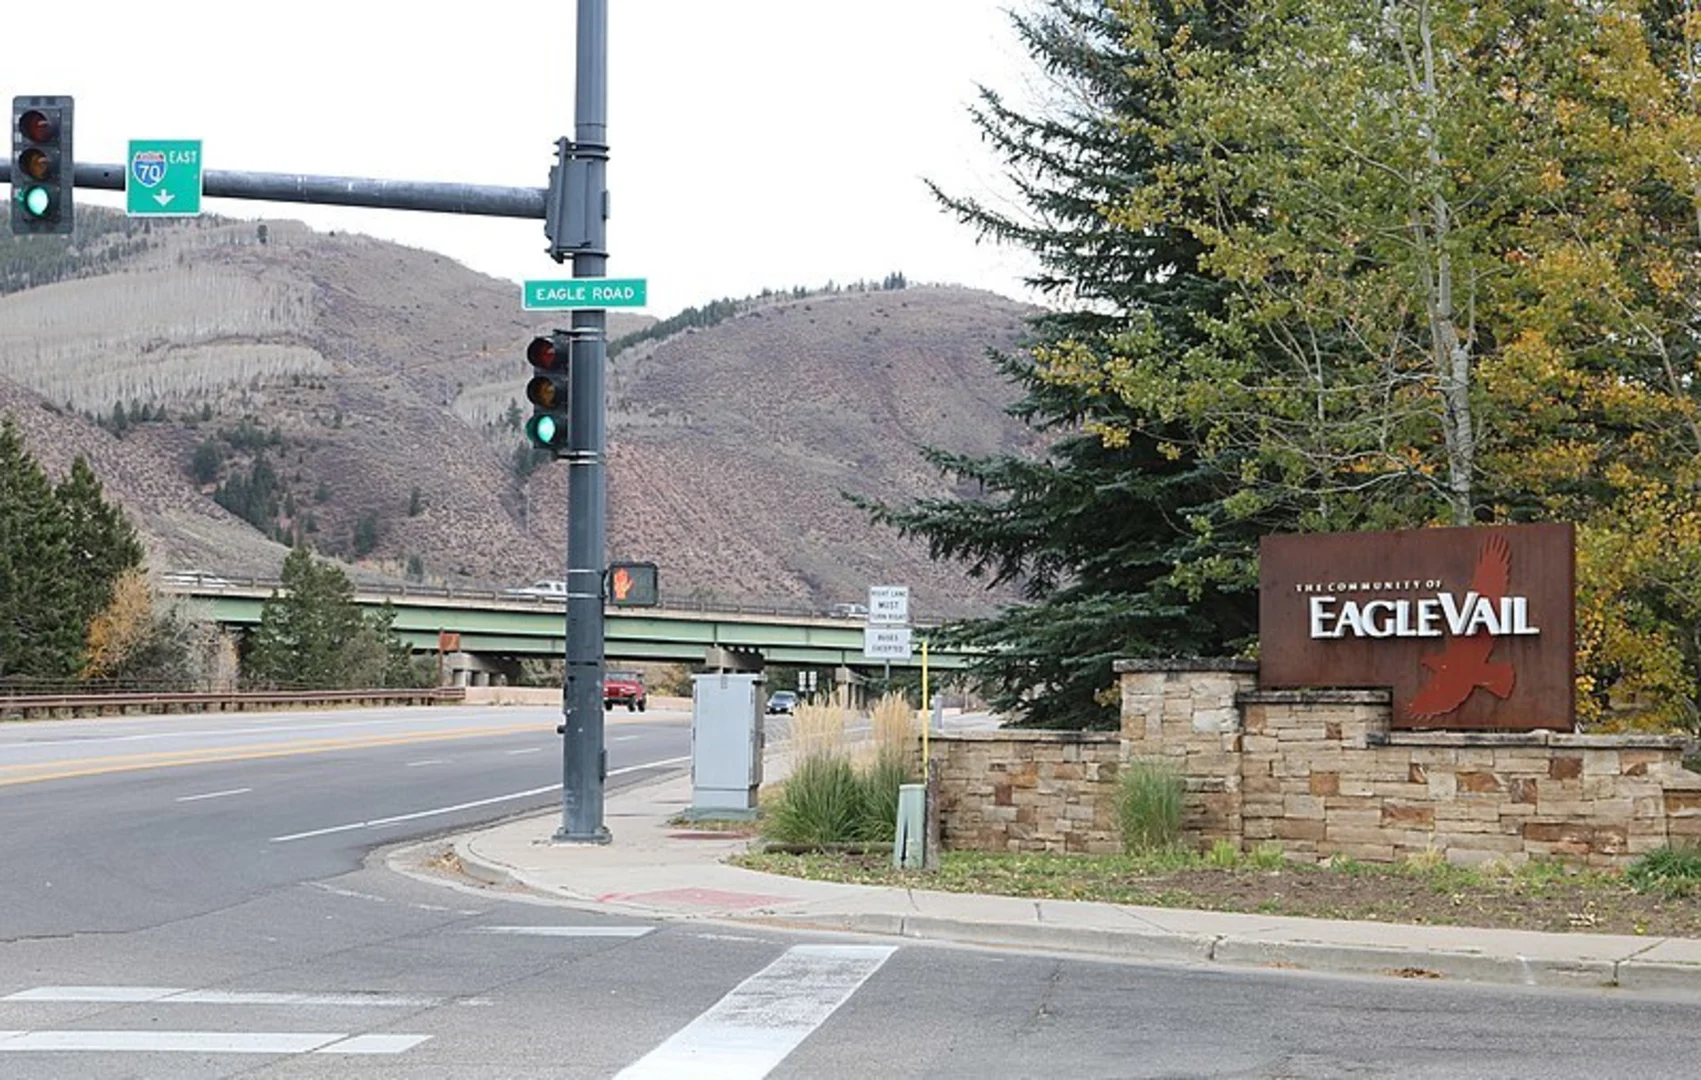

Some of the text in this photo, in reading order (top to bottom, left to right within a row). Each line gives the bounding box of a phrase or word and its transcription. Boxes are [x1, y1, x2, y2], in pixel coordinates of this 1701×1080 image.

[169, 150, 198, 164] EAST
[138, 165, 161, 181] 70
[535, 286, 635, 301] EAGLE ROAD
[1295, 579, 1442, 592] THE COMMUNITY OF
[878, 601, 899, 610] MUST
[1309, 591, 1541, 639] EAGLEVAIL
